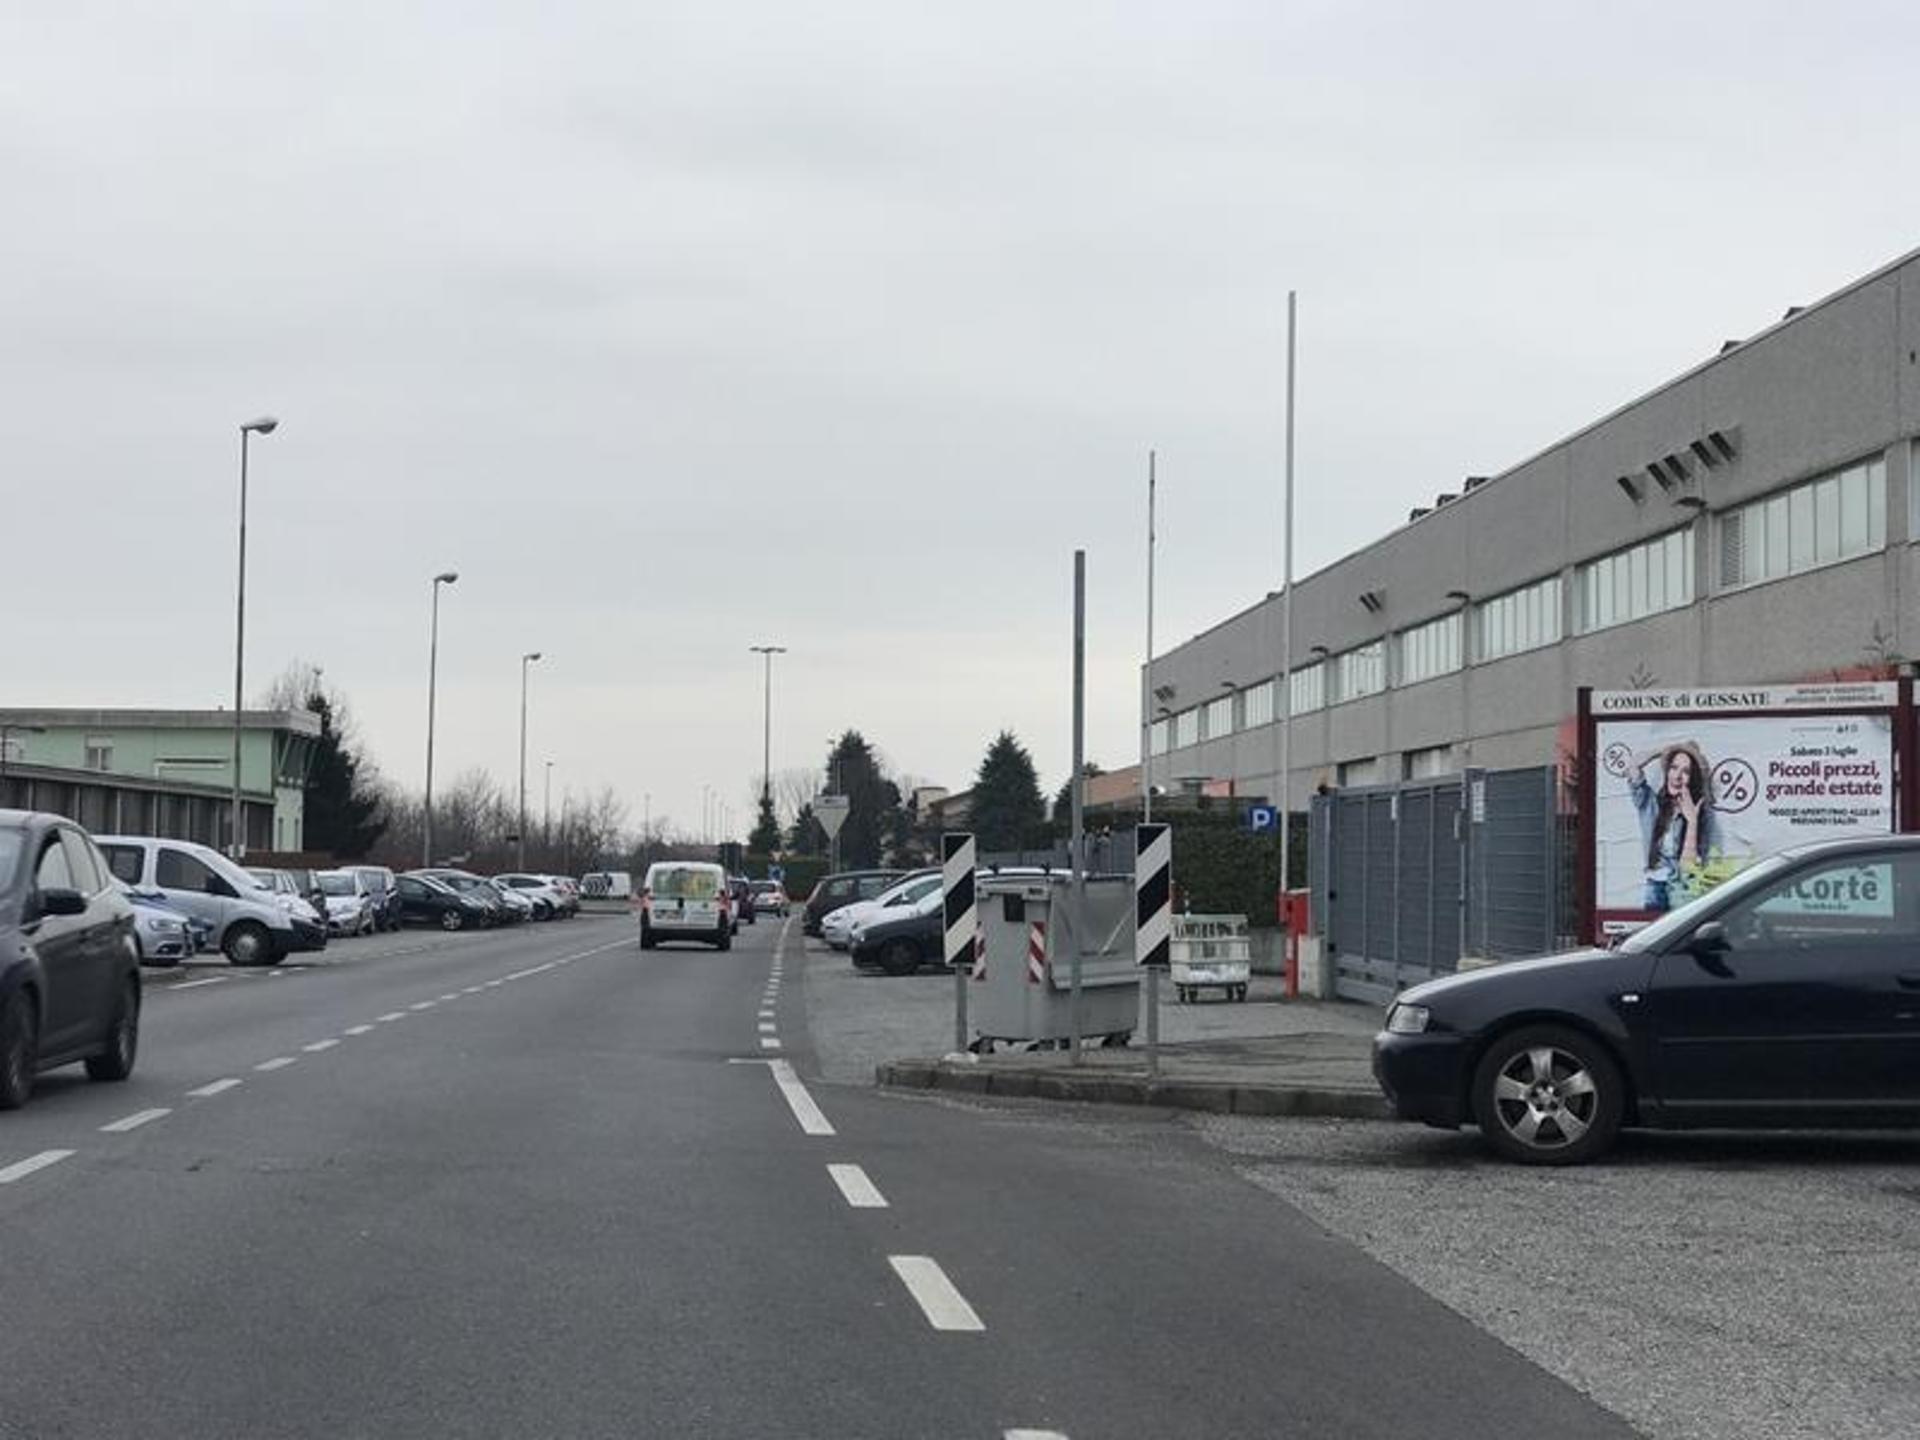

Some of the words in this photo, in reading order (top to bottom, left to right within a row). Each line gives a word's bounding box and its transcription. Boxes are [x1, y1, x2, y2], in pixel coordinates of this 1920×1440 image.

[1602, 695, 1670, 709] COMUNE
[1675, 693, 1690, 707] di
[1696, 691, 1770, 707] GESSATE
[1769, 761, 1820, 777] Piccoli
[1824, 761, 1880, 781] prezzi,
[1766, 780, 1825, 801] grande
[1828, 781, 1882, 795] estate
[1252, 808, 1270, 831] P
